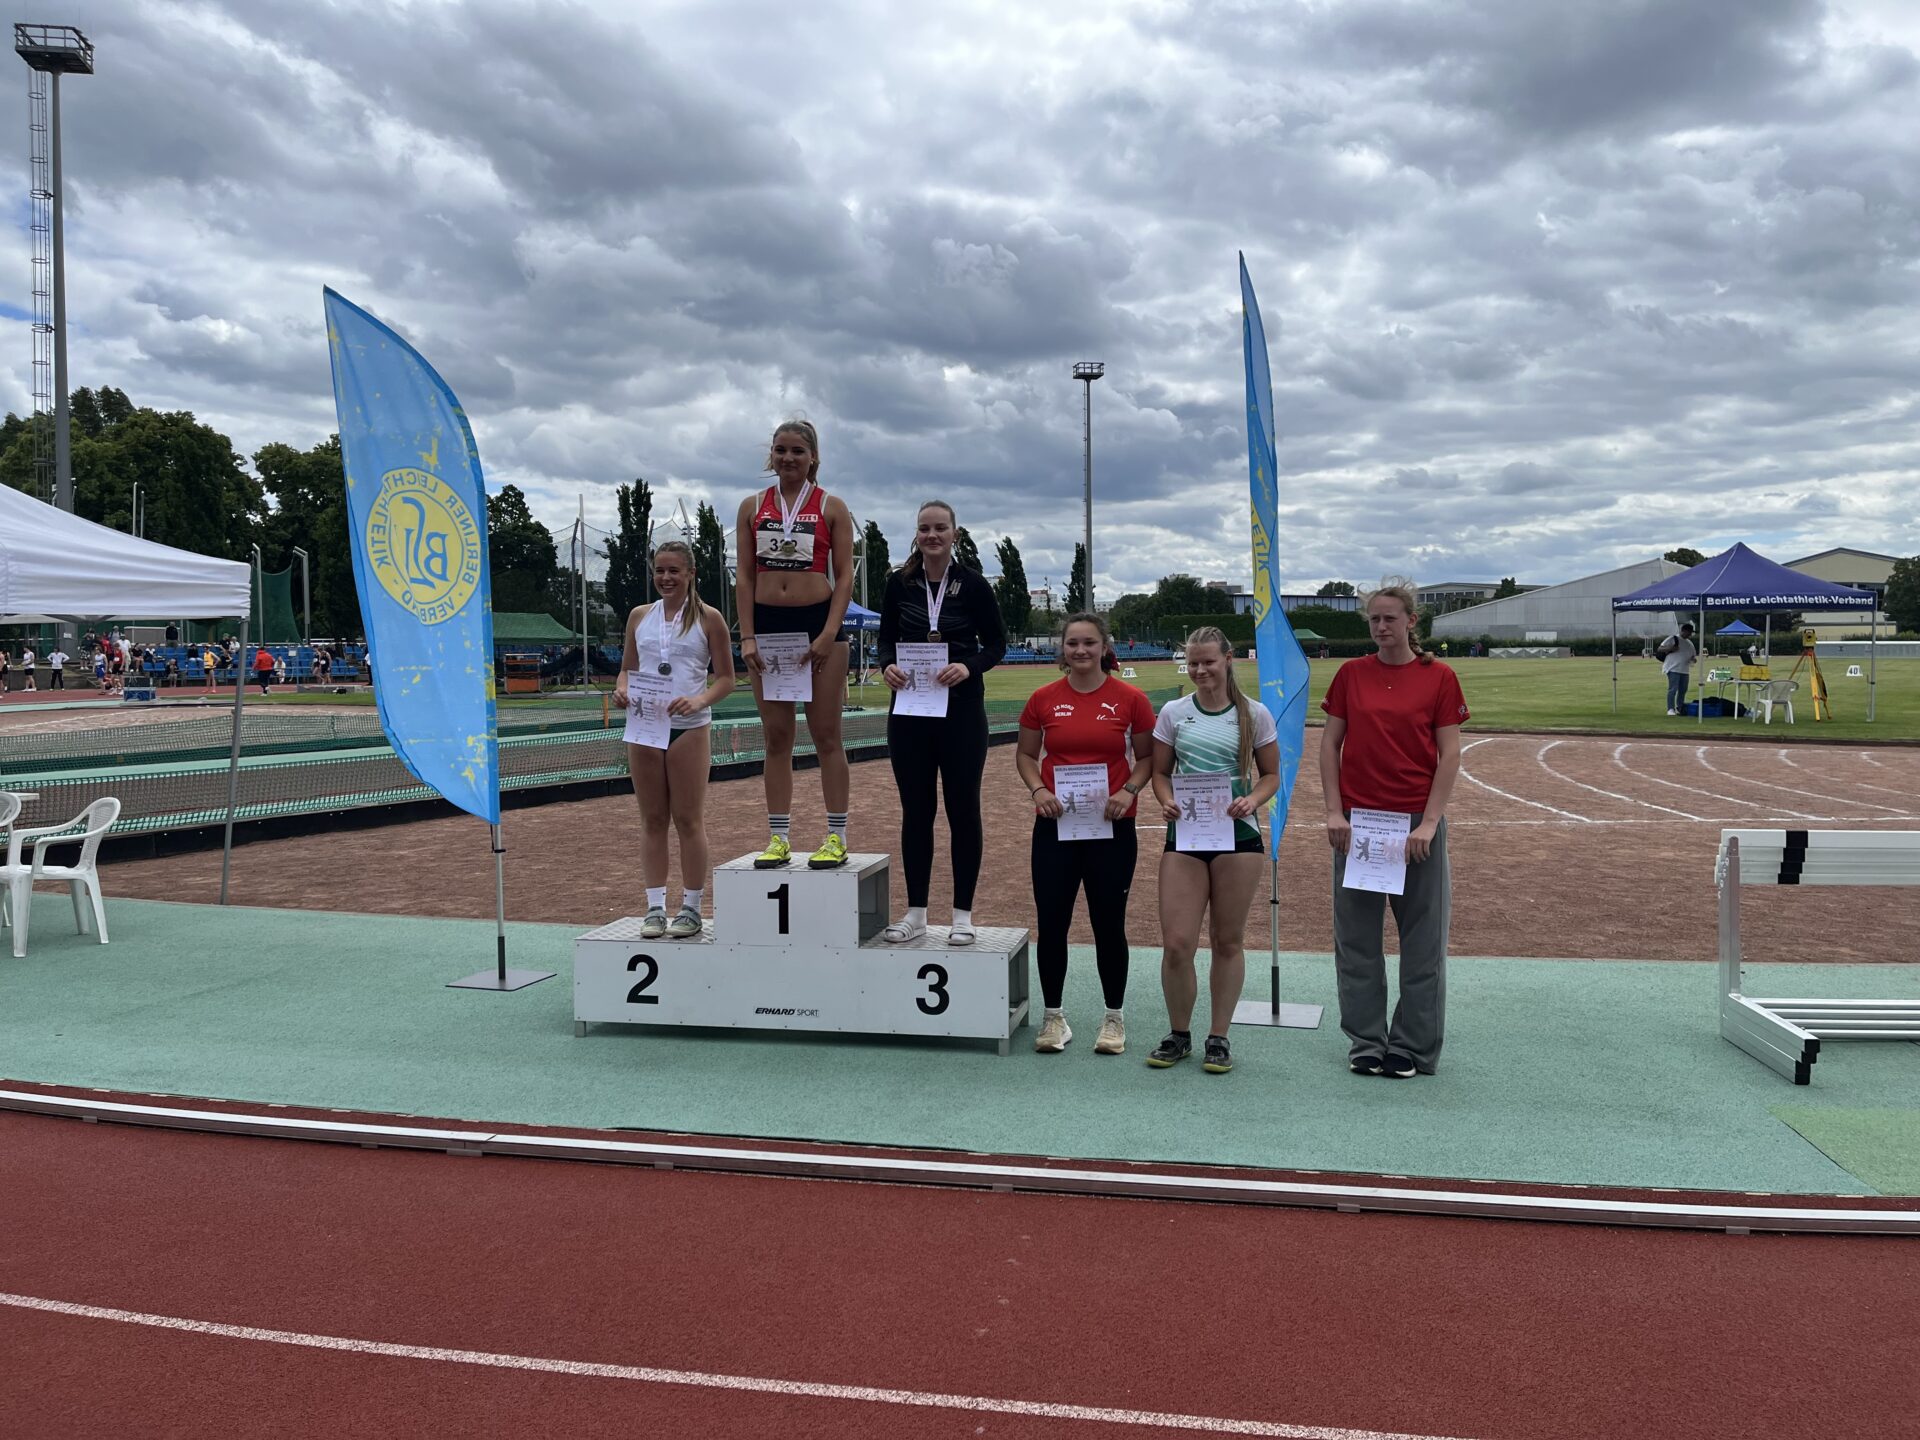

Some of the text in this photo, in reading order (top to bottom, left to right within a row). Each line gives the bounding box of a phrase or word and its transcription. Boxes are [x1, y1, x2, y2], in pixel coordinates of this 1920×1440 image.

[1706, 595, 1874, 606] Berliner Leichtathletik-Verband
[767, 883, 790, 935] 1
[626, 954, 660, 1005] 2
[915, 963, 950, 1016] 3
[755, 1007, 819, 1017] ERHARD SPORT
